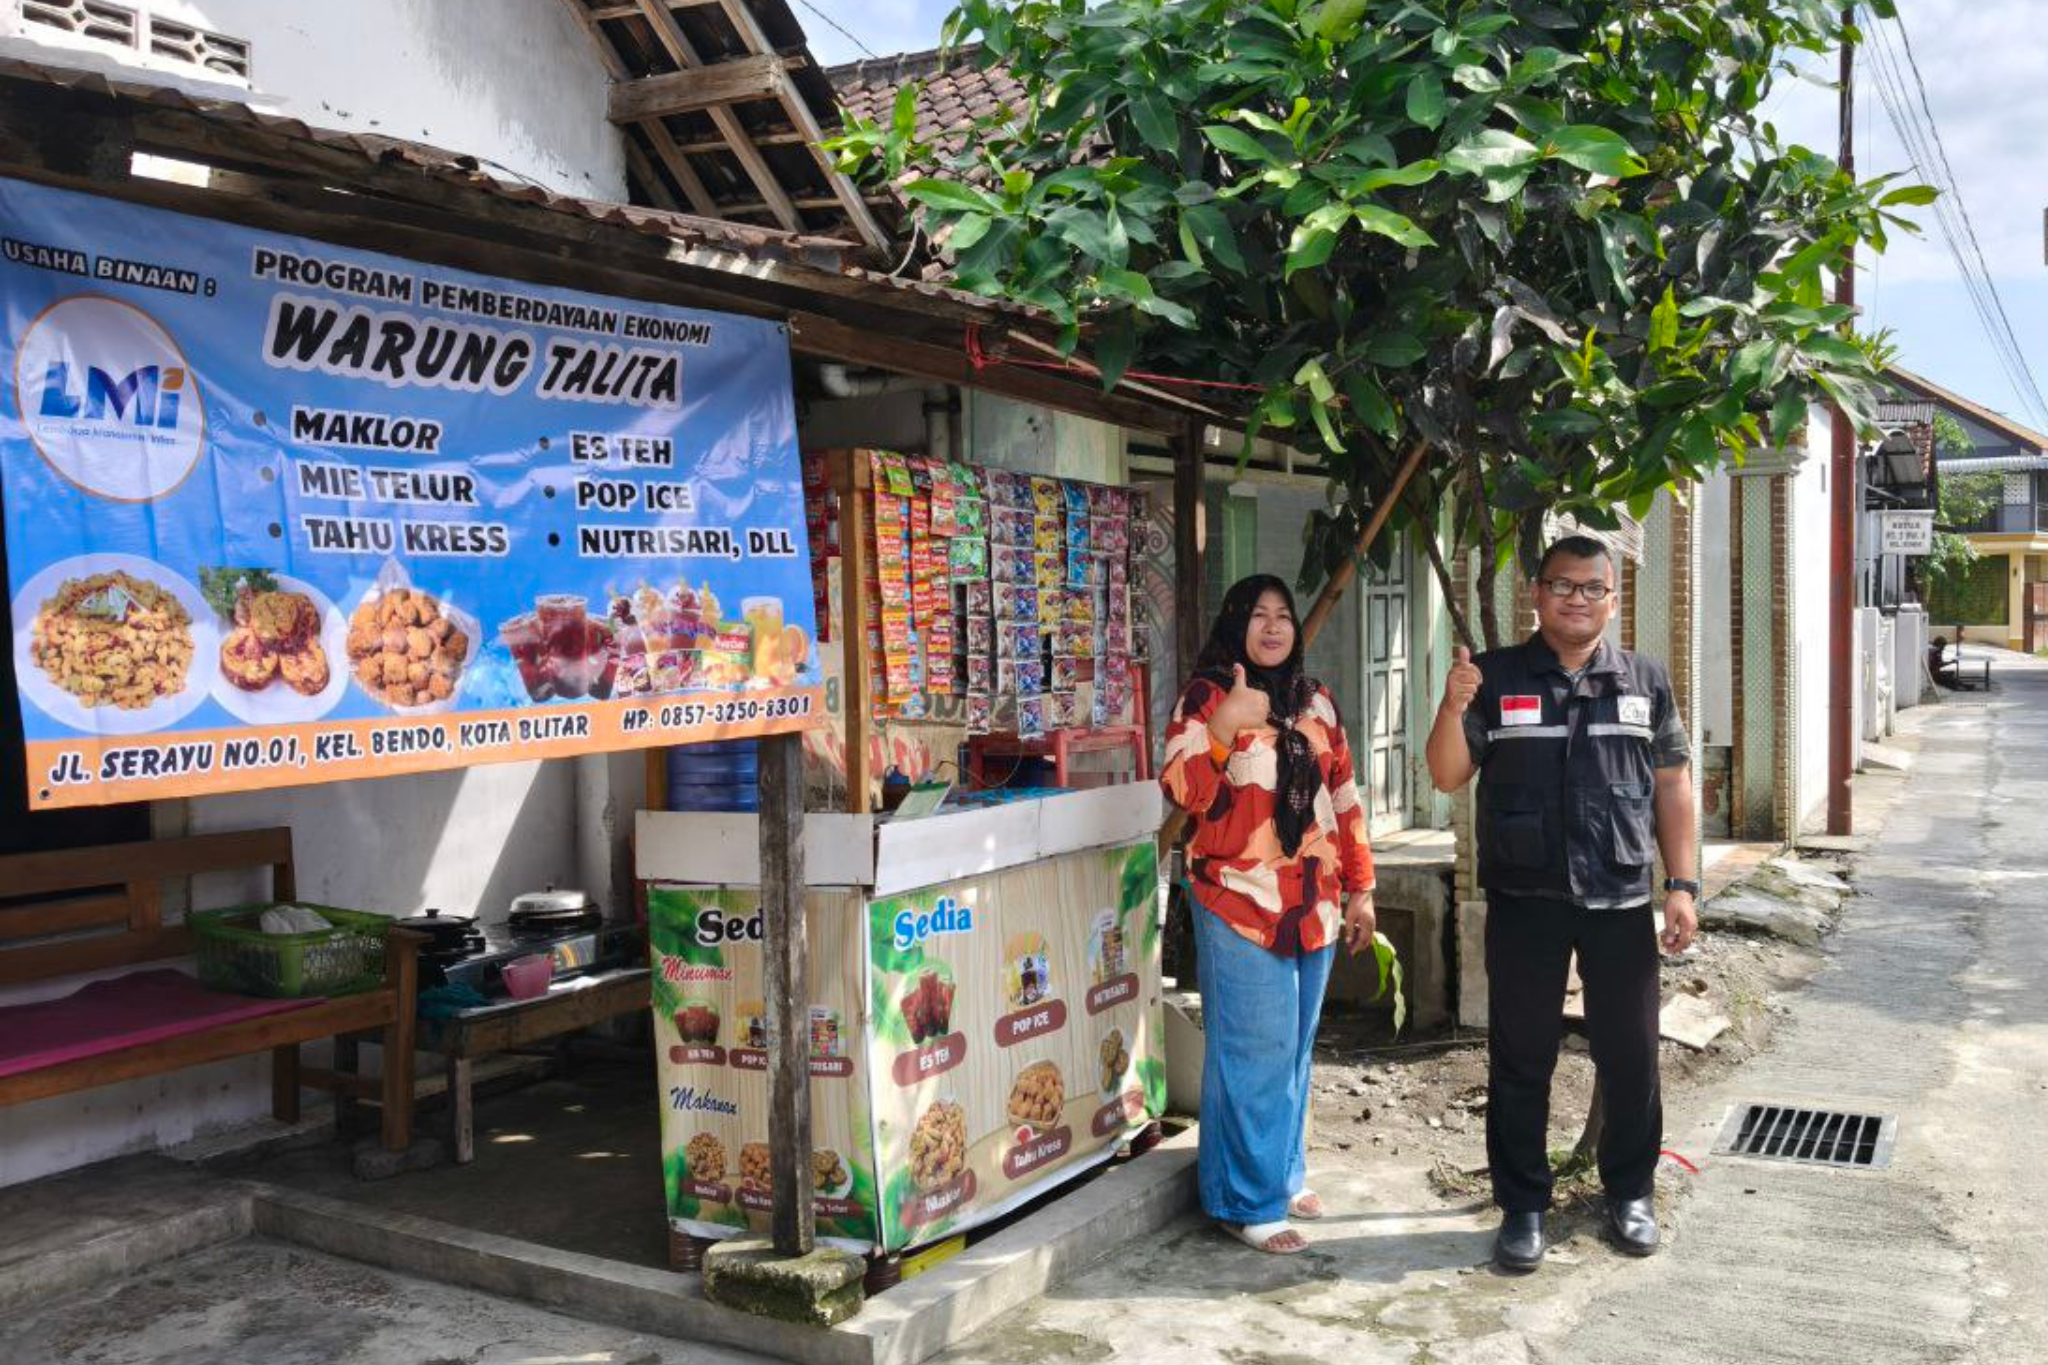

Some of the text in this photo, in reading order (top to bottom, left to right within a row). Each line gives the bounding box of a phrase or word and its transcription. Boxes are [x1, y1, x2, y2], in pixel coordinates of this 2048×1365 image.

[3, 239, 88, 277] USAHA
[96, 257, 198, 294] BINAAN
[254, 248, 711, 345] PROGRAM PEMBERDAYAAN EKONOMI
[270, 300, 680, 404] WARUNG TALITA
[294, 408, 441, 452] MAKLOR
[571, 434, 672, 465] ES TEH
[301, 464, 474, 503] MIE TELUR
[577, 482, 692, 510] POP ICE
[306, 515, 508, 554] TAHU KRESS
[580, 528, 796, 558] NUTRISARI, DLL
[51, 754, 91, 783] JL.
[101, 745, 213, 779] SERAYU
[223, 736, 306, 768] NO.01,
[315, 734, 362, 760] KEL.
[372, 726, 453, 754] BENDO,
[460, 721, 510, 748] KOTA
[519, 715, 588, 741] BLITAR
[622, 709, 653, 730] HP:
[698, 909, 766, 943] Sed
[895, 897, 973, 948] Sedia
[661, 955, 733, 981] Minuman
[1012, 1011, 1050, 1036] POP ICE
[741, 1054, 767, 1067] POP IC
[919, 1051, 936, 1071] ES
[671, 1086, 738, 1116] Makanan
